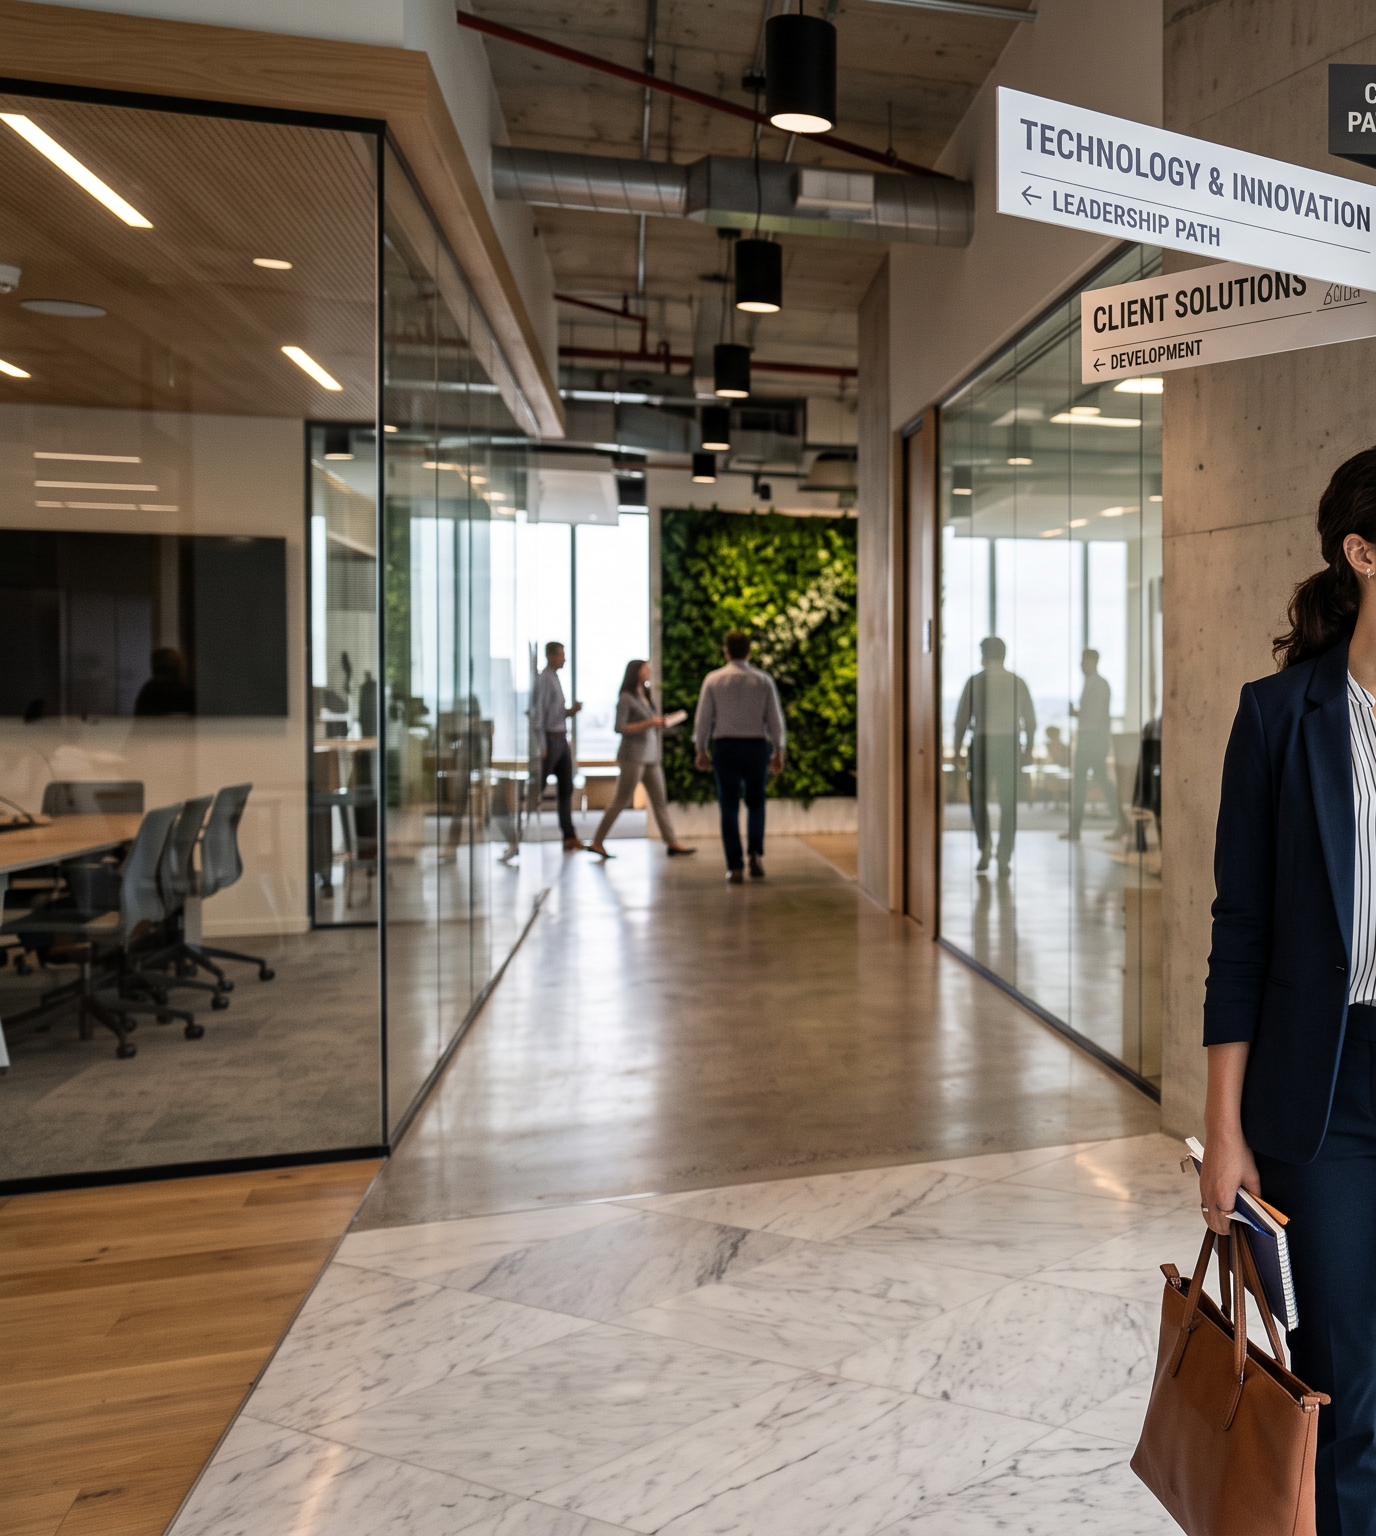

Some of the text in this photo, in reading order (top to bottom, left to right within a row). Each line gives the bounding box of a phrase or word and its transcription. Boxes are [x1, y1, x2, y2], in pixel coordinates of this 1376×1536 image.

[1020, 118, 1370, 232] TECHNOLOGY & INNOVATION
[1053, 191, 1219, 246] LEADERSHIP PATH
[1094, 294, 1168, 333] CLIENT
[1175, 272, 1306, 318] SOLUTIONS
[1111, 339, 1202, 369] DEVELOPMENT
